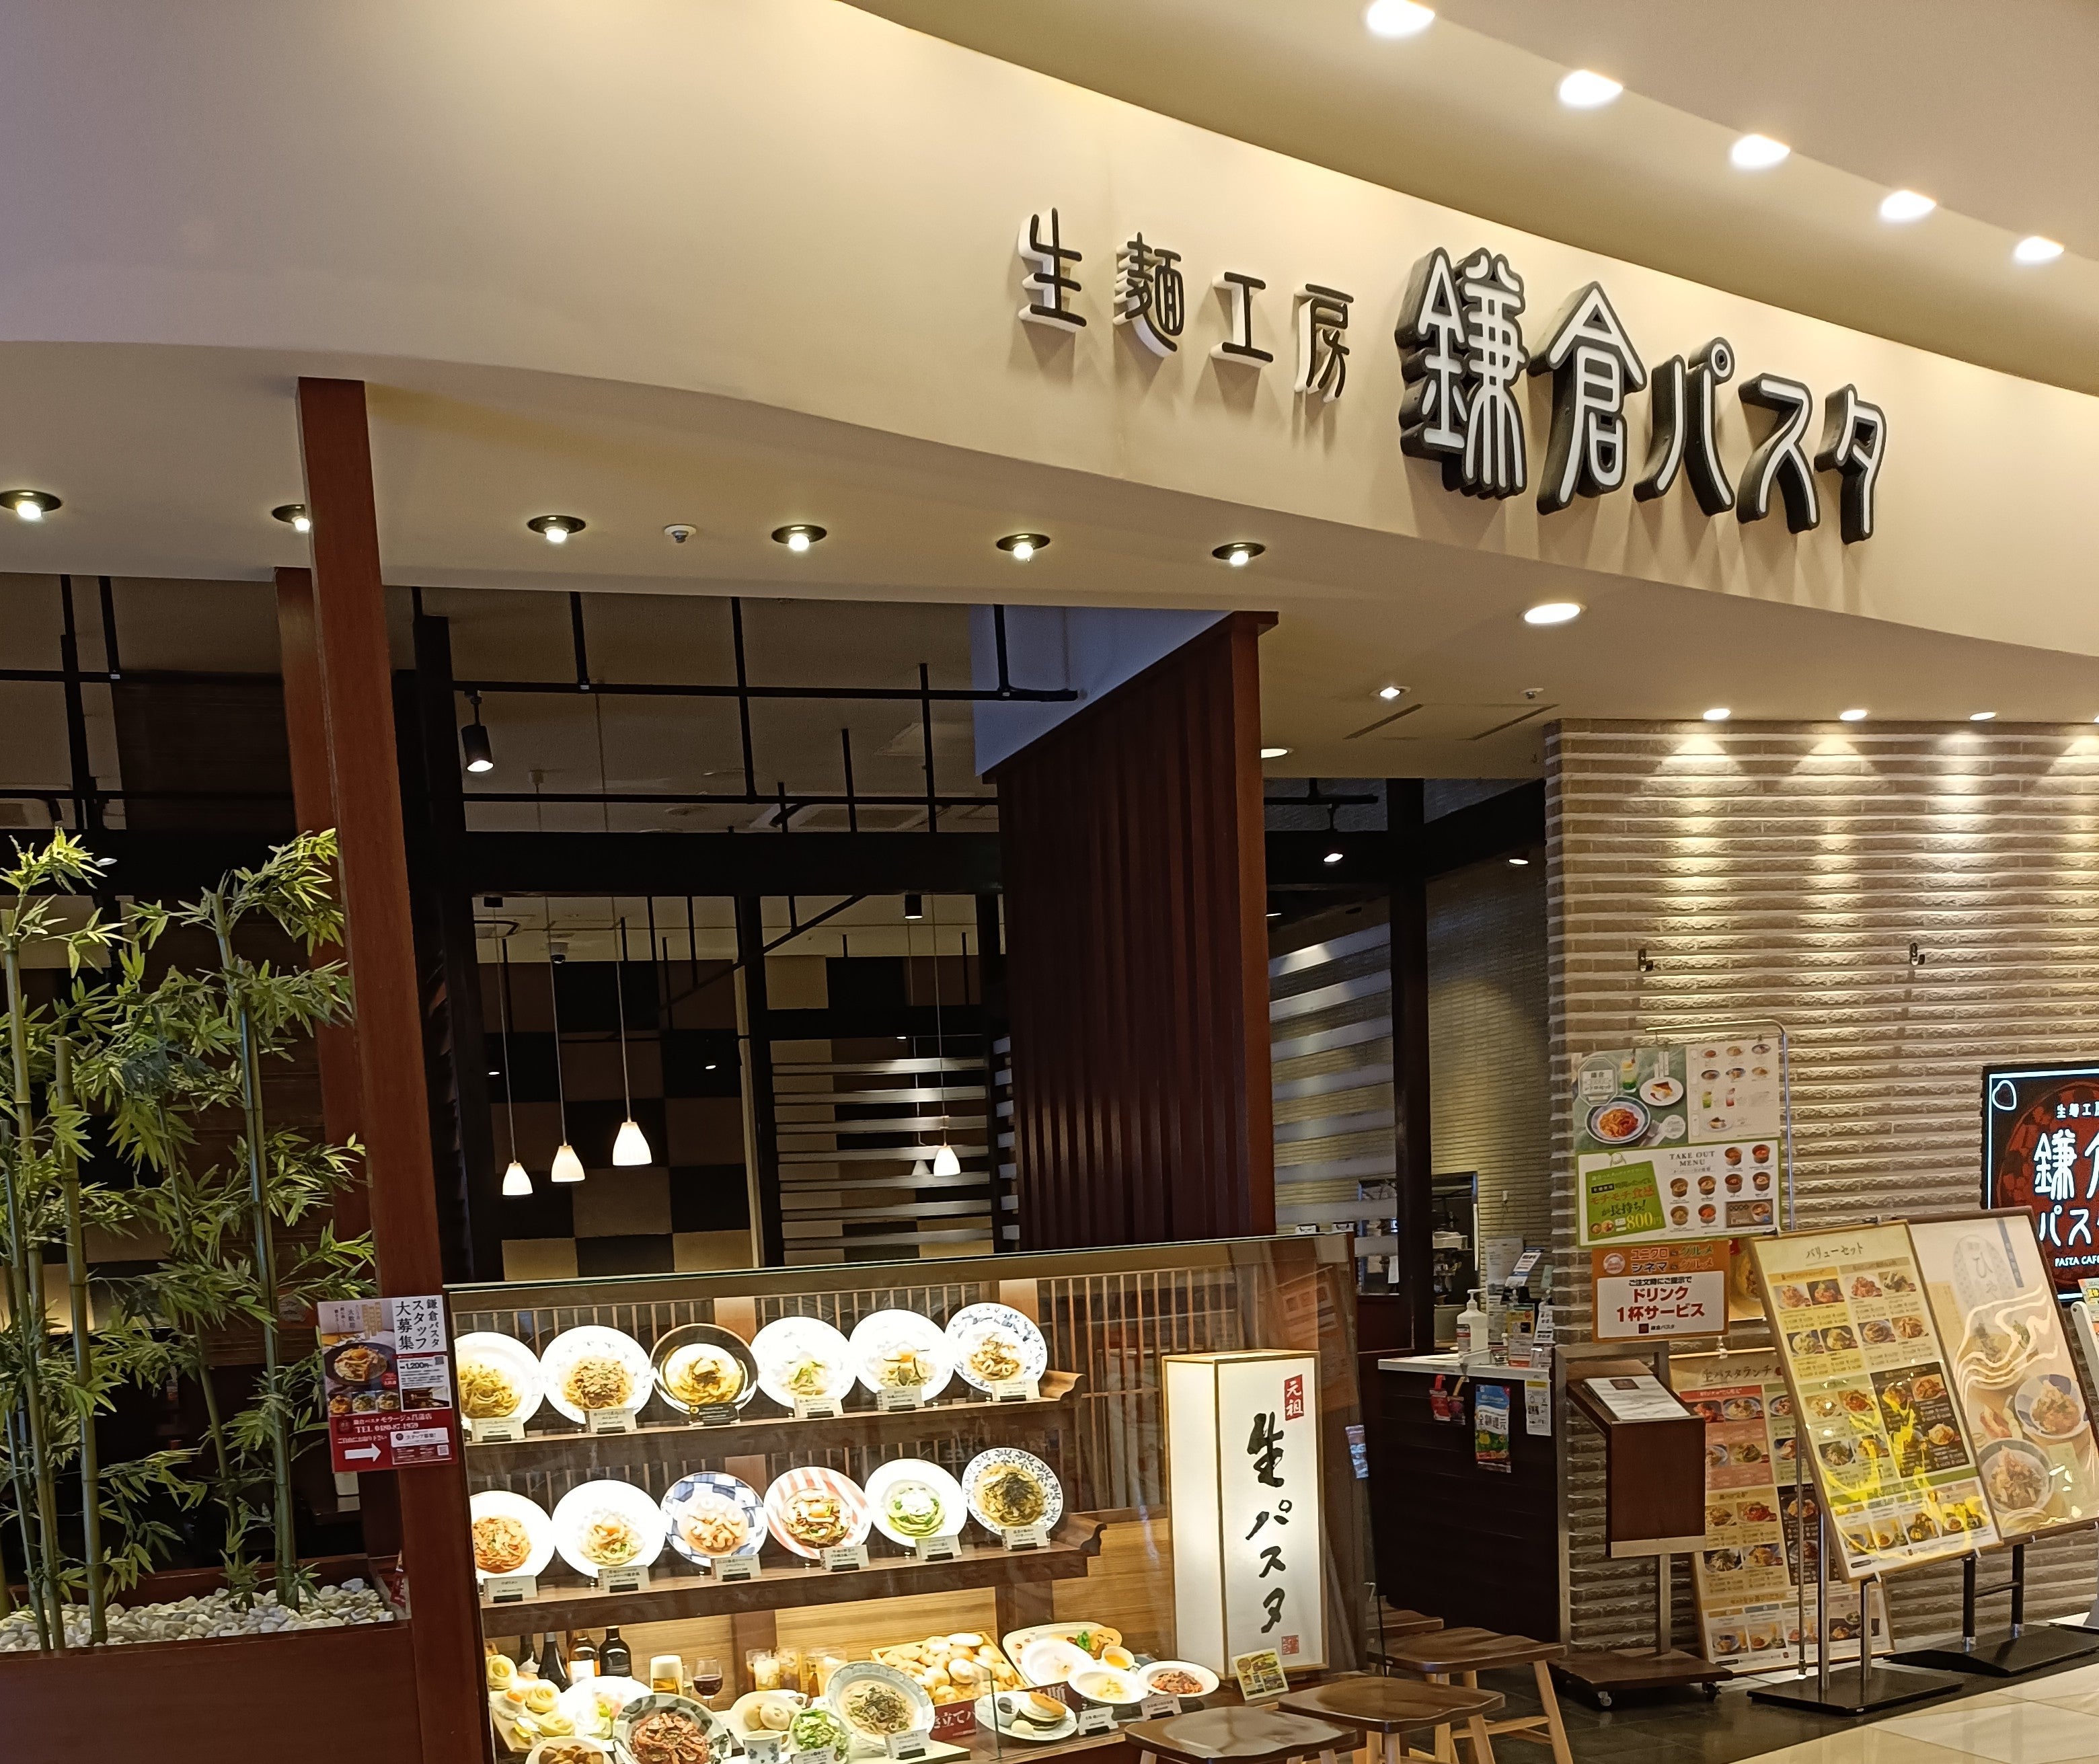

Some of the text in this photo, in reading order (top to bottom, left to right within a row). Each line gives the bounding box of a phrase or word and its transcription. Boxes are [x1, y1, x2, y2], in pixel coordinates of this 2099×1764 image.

[1395, 246, 1887, 545] 鎌倉パスタ
[2038, 1204, 2099, 1246] パス
[1631, 1247, 1669, 1260] ユニクロ
[1632, 1261, 1668, 1273] シネマ
[1806, 1242, 1863, 1259] バリューセット
[2055, 1258, 2079, 1268] PASTA
[1617, 1303, 1705, 1322] 1杯サービス
[1634, 1286, 1689, 1303] ドリンク
[395, 1301, 414, 1350] 大募集
[412, 1299, 428, 1350] スタッフ
[426, 1299, 439, 1347] 鎌倉パスタ
[1286, 1379, 1303, 1417] 元祖
[1246, 1411, 1292, 1634] 生パスタ
